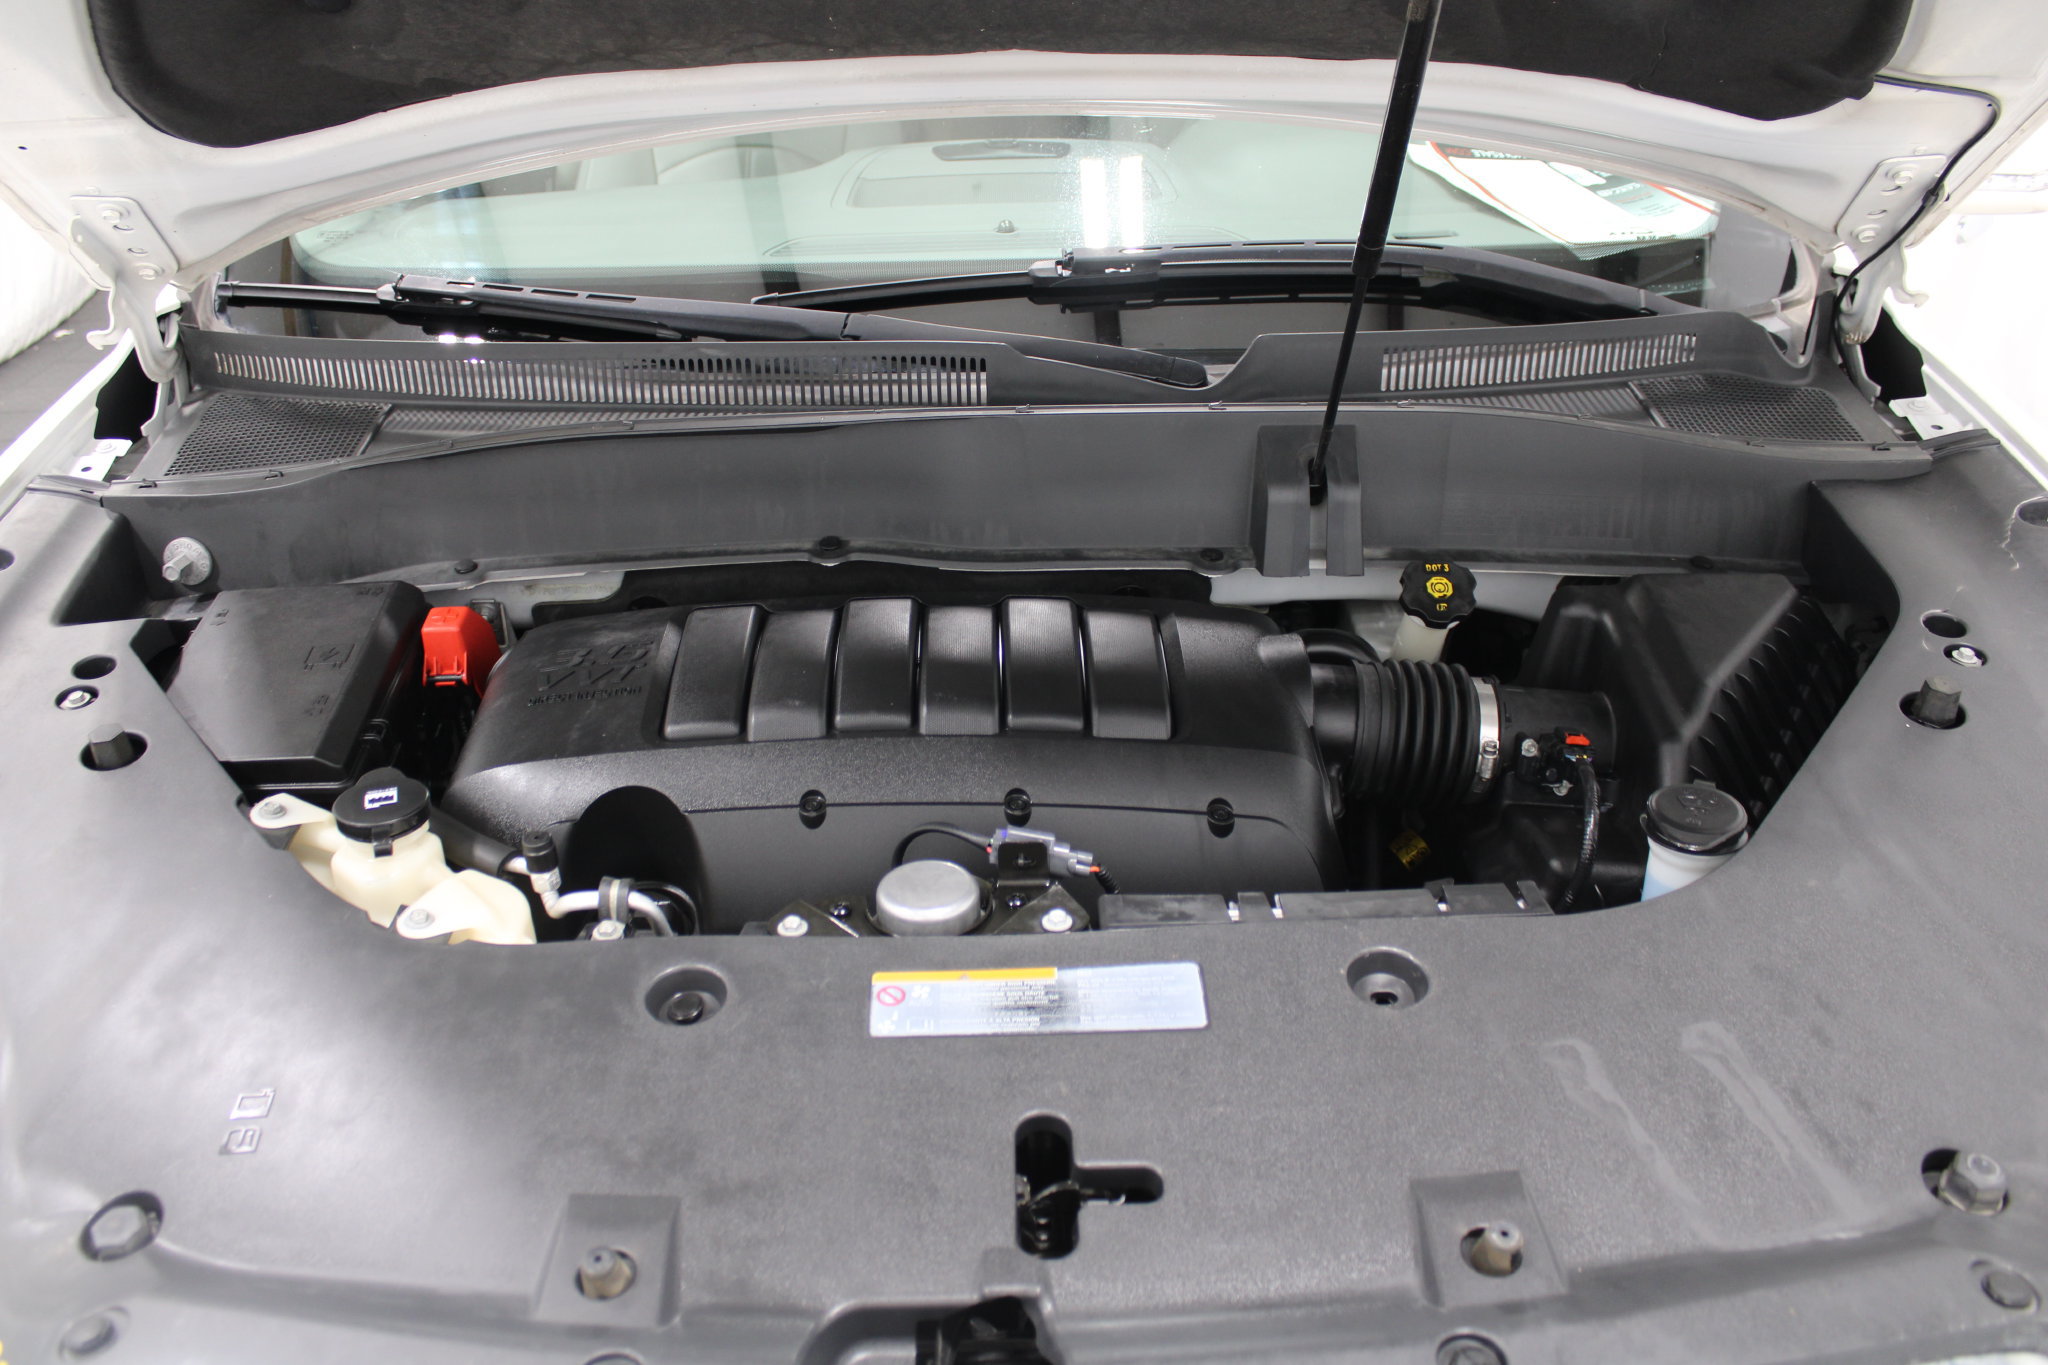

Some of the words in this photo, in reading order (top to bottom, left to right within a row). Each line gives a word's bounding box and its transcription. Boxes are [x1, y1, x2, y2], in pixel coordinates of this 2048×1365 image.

[1425, 563, 1442, 572] DOT
[1443, 563, 1449, 572] 3
[537, 663, 648, 691] VVT
